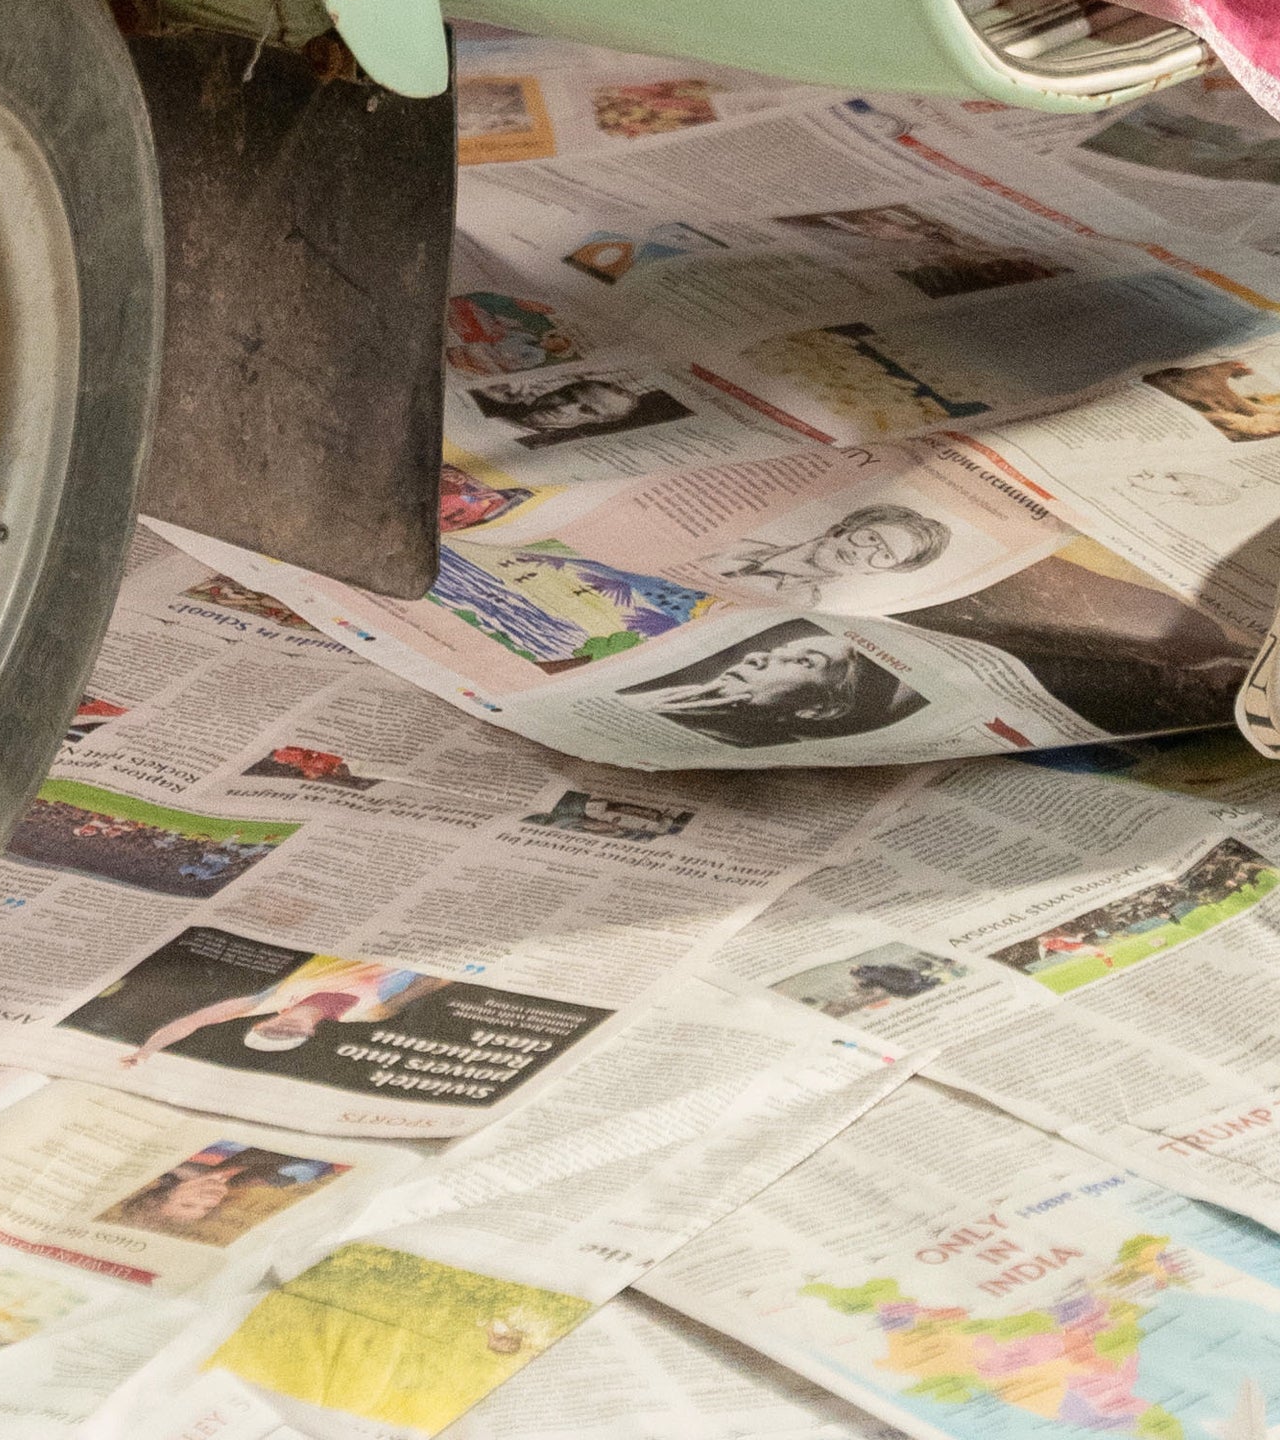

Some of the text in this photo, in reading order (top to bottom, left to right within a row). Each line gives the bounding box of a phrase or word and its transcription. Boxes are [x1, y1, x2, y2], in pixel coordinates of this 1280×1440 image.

[947, 911, 1025, 949] Arsenal
[369, 1031, 535, 1069] Raducanu
[470, 1030, 553, 1054] clash
[336, 1044, 520, 1083] powers into
[369, 1070, 496, 1100] Swiatek
[1157, 1107, 1274, 1159] TRUMP
[915, 1212, 1009, 1265] ONLY
[976, 1238, 1025, 1266] IN
[977, 1246, 1085, 1298] INDIA
